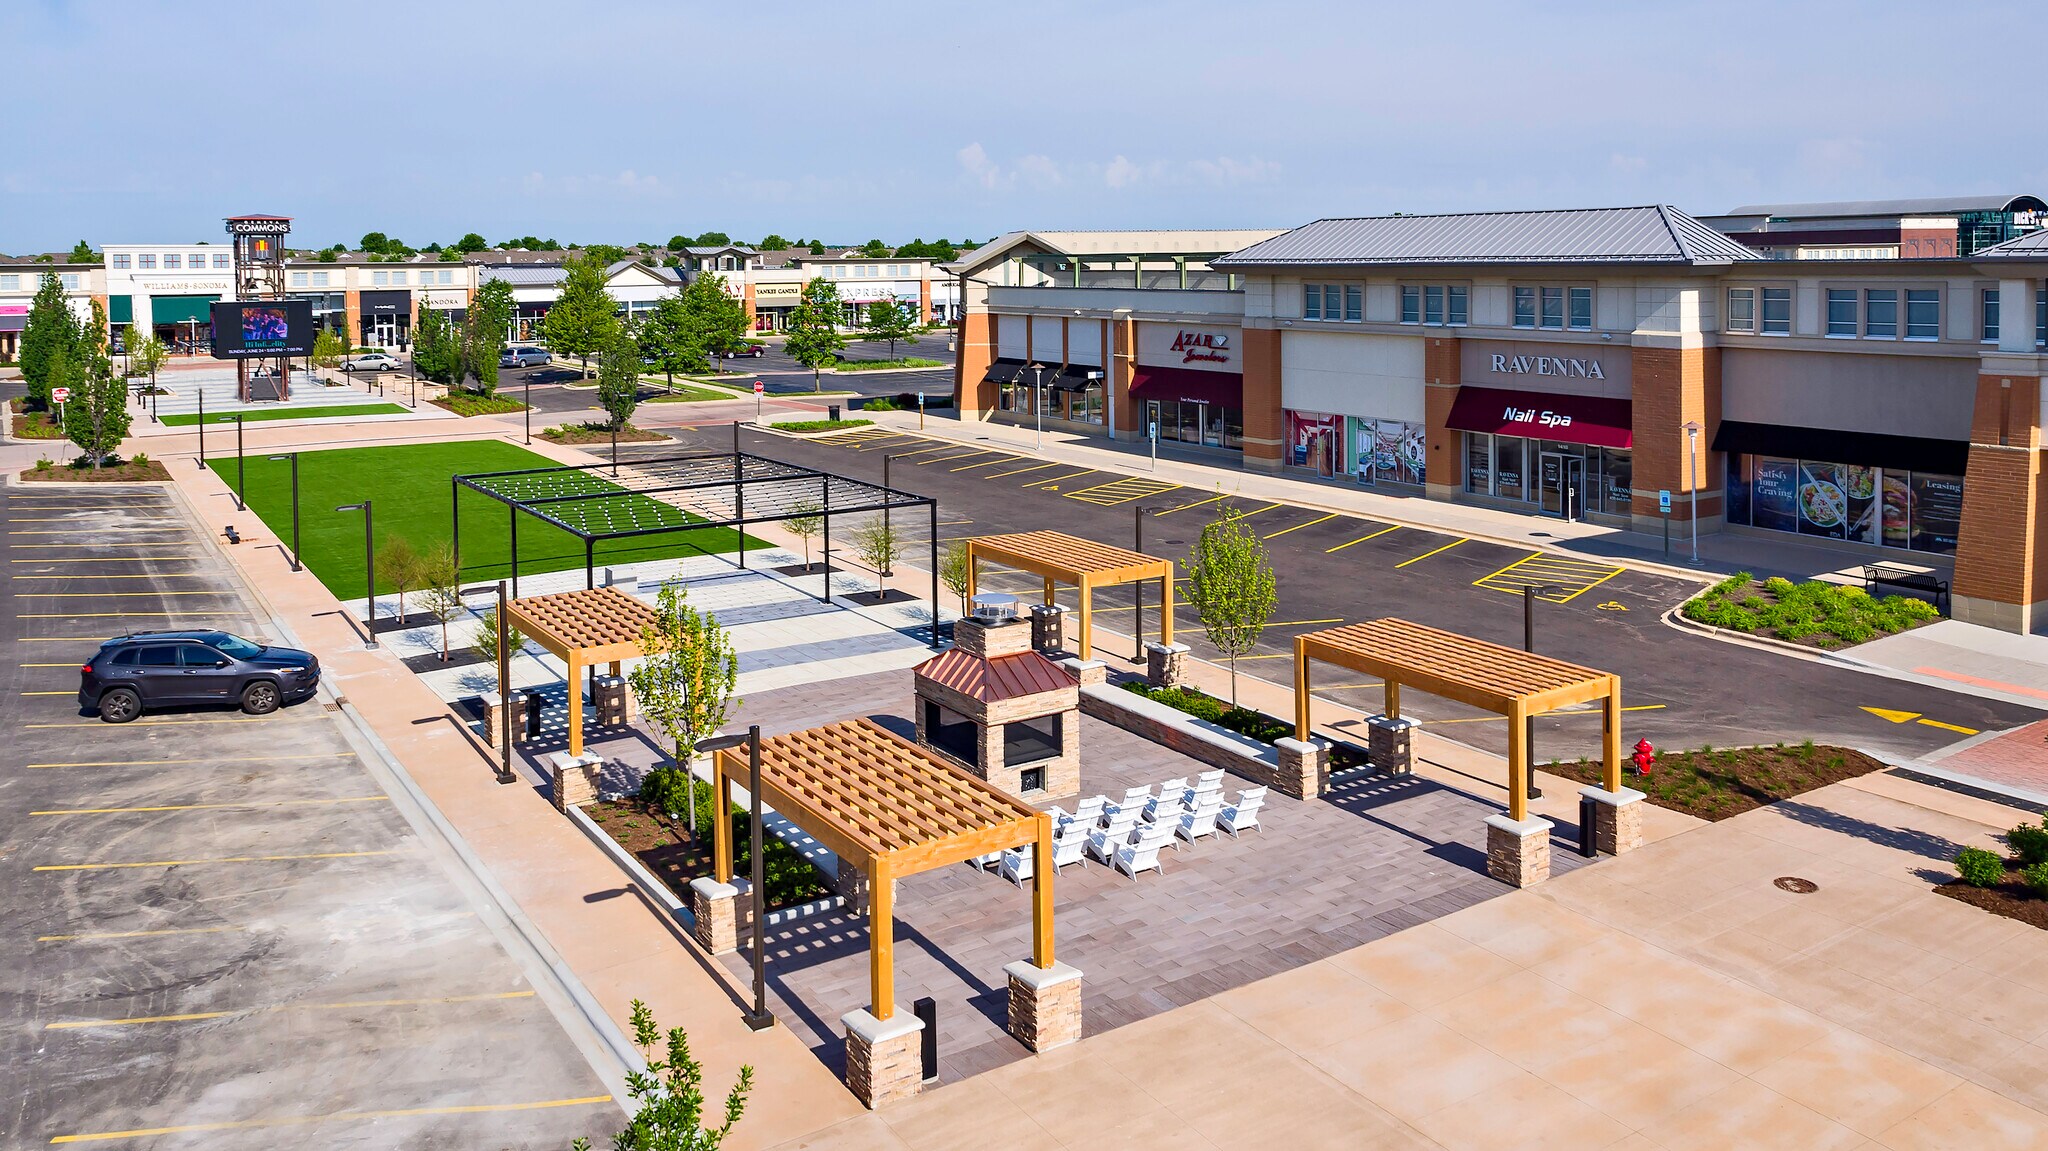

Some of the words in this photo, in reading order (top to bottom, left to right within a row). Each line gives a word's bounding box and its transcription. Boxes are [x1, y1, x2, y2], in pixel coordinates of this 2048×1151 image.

[235, 224, 288, 232] COMMONS
[143, 282, 228, 290] WILLIAMS-SONOMA
[839, 287, 893, 298] EXPRESS
[1170, 330, 1229, 351] AZAR
[1182, 348, 1229, 363] Jewelers
[1490, 353, 1605, 380] RAVENNA
[1502, 406, 1536, 423] Nail
[1538, 410, 1572, 428] Spa
[1758, 469, 1787, 481] Satisfy
[1758, 477, 1779, 487] Your
[1926, 480, 1961, 493] Leasing
[1757, 485, 1793, 500] Craving
